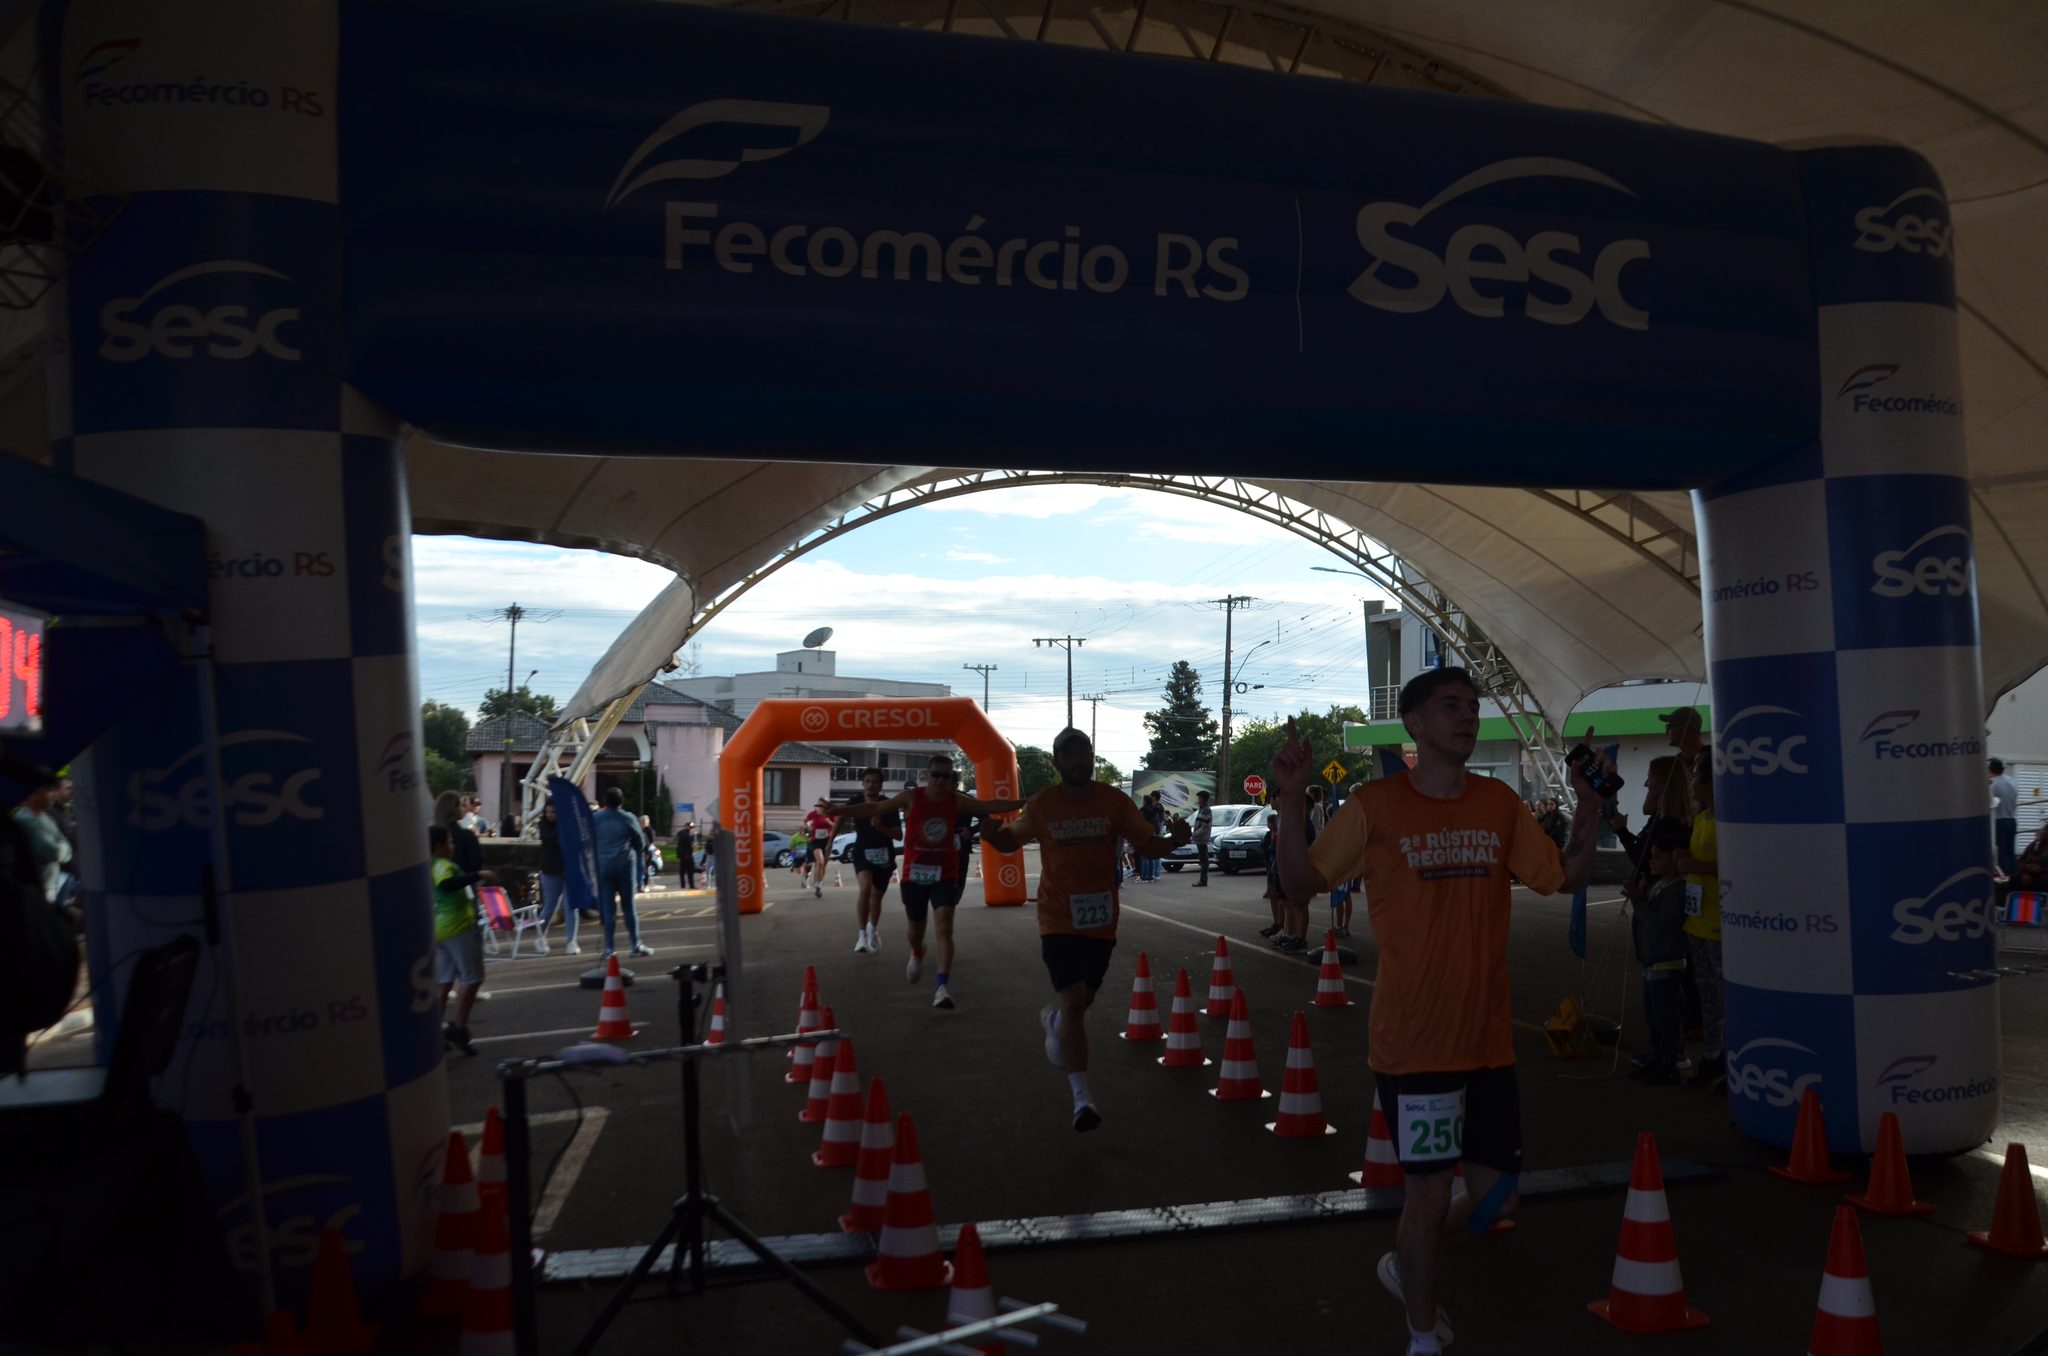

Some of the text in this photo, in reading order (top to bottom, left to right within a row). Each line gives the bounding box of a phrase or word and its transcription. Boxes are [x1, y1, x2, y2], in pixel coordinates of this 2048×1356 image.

[85, 77, 324, 117] Fecomércio RS
[664, 201, 1251, 301] Fecomércio RS
[1347, 200, 1651, 331] Sesc
[98, 301, 302, 363] Sesc
[293, 551, 335, 577] RS
[1786, 571, 1819, 593] RS
[837, 707, 940, 729] CRESOL
[734, 780, 752, 868] CRESOL
[1426, 827, 1501, 849] RÚSTICA
[1406, 847, 1499, 869] REGIONAL
[1076, 904, 1109, 927] 223
[1805, 914, 1839, 934] RS
[329, 998, 367, 1029] RS
